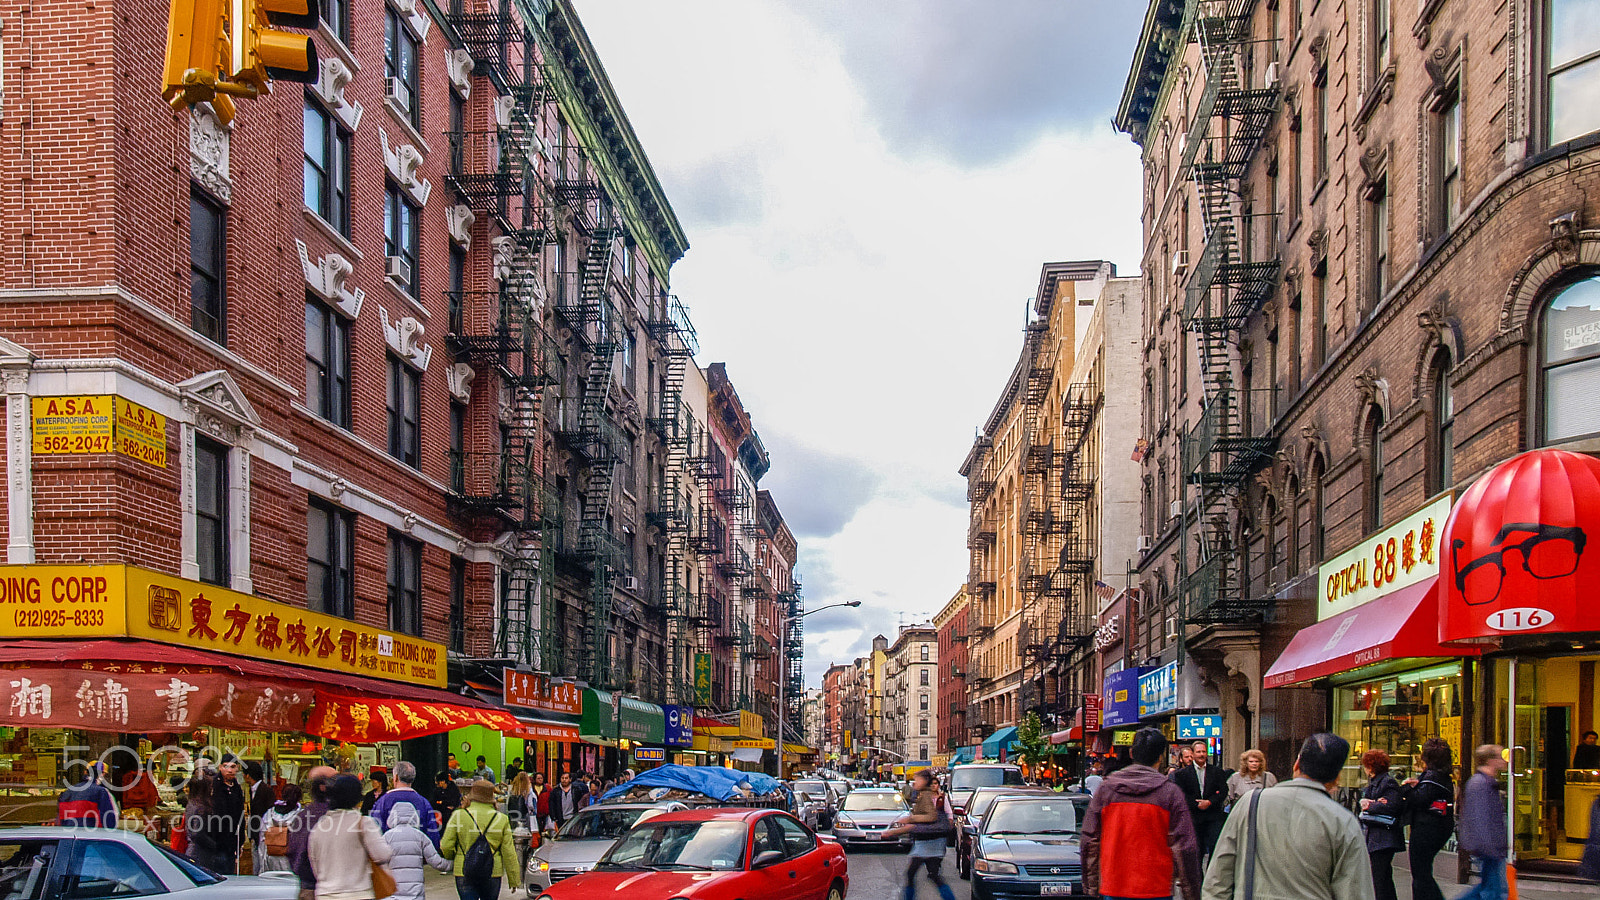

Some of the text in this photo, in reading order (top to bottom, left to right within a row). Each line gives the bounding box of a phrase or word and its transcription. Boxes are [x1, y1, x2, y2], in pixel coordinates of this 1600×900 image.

[1565, 322, 1600, 338] SILVER
[46, 399, 99, 416] A.S.A.
[36, 416, 89, 425] WATERPROOFING
[44, 435, 110, 451] 562-2047
[123, 437, 165, 465] 562-2047
[1326, 517, 1437, 603] OPTICAL 88 眼鏡
[51, 576, 108, 603] CORP.
[14, 608, 104, 628] (212)925-8333
[1497, 610, 1543, 628] 116
[188, 592, 358, 667] 東方海味公司
[380, 639, 437, 666] A.T. TRADING CORP.
[1354, 647, 1381, 665] OPTICAL 88
[386, 660, 400, 675] MOTT
